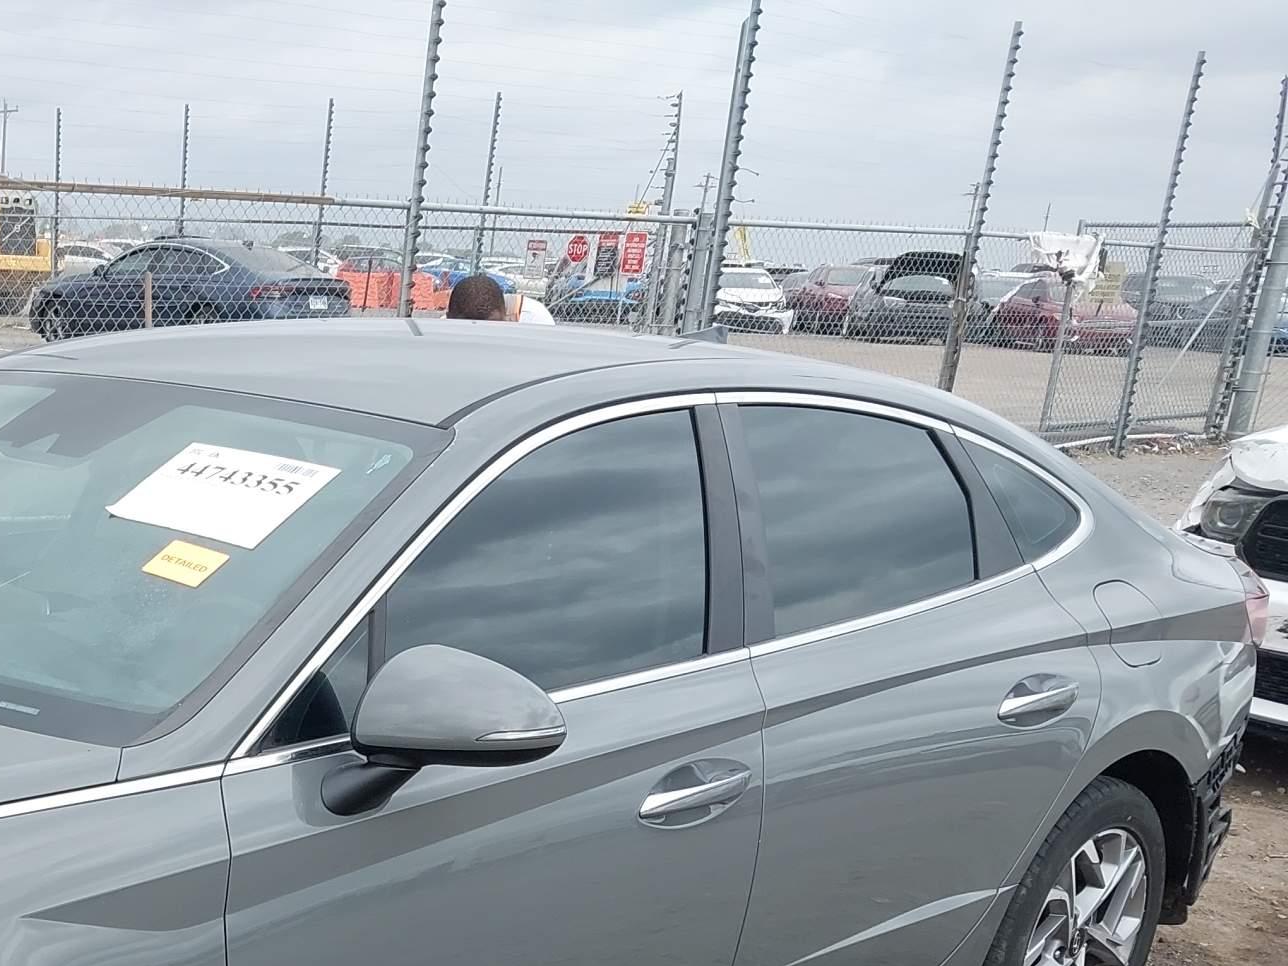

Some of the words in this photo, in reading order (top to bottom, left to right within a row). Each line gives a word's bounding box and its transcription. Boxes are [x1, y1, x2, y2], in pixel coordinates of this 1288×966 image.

[568, 242, 588, 256] STOP
[176, 461, 301, 496] 44743355
[160, 553, 208, 574] DETAILED
